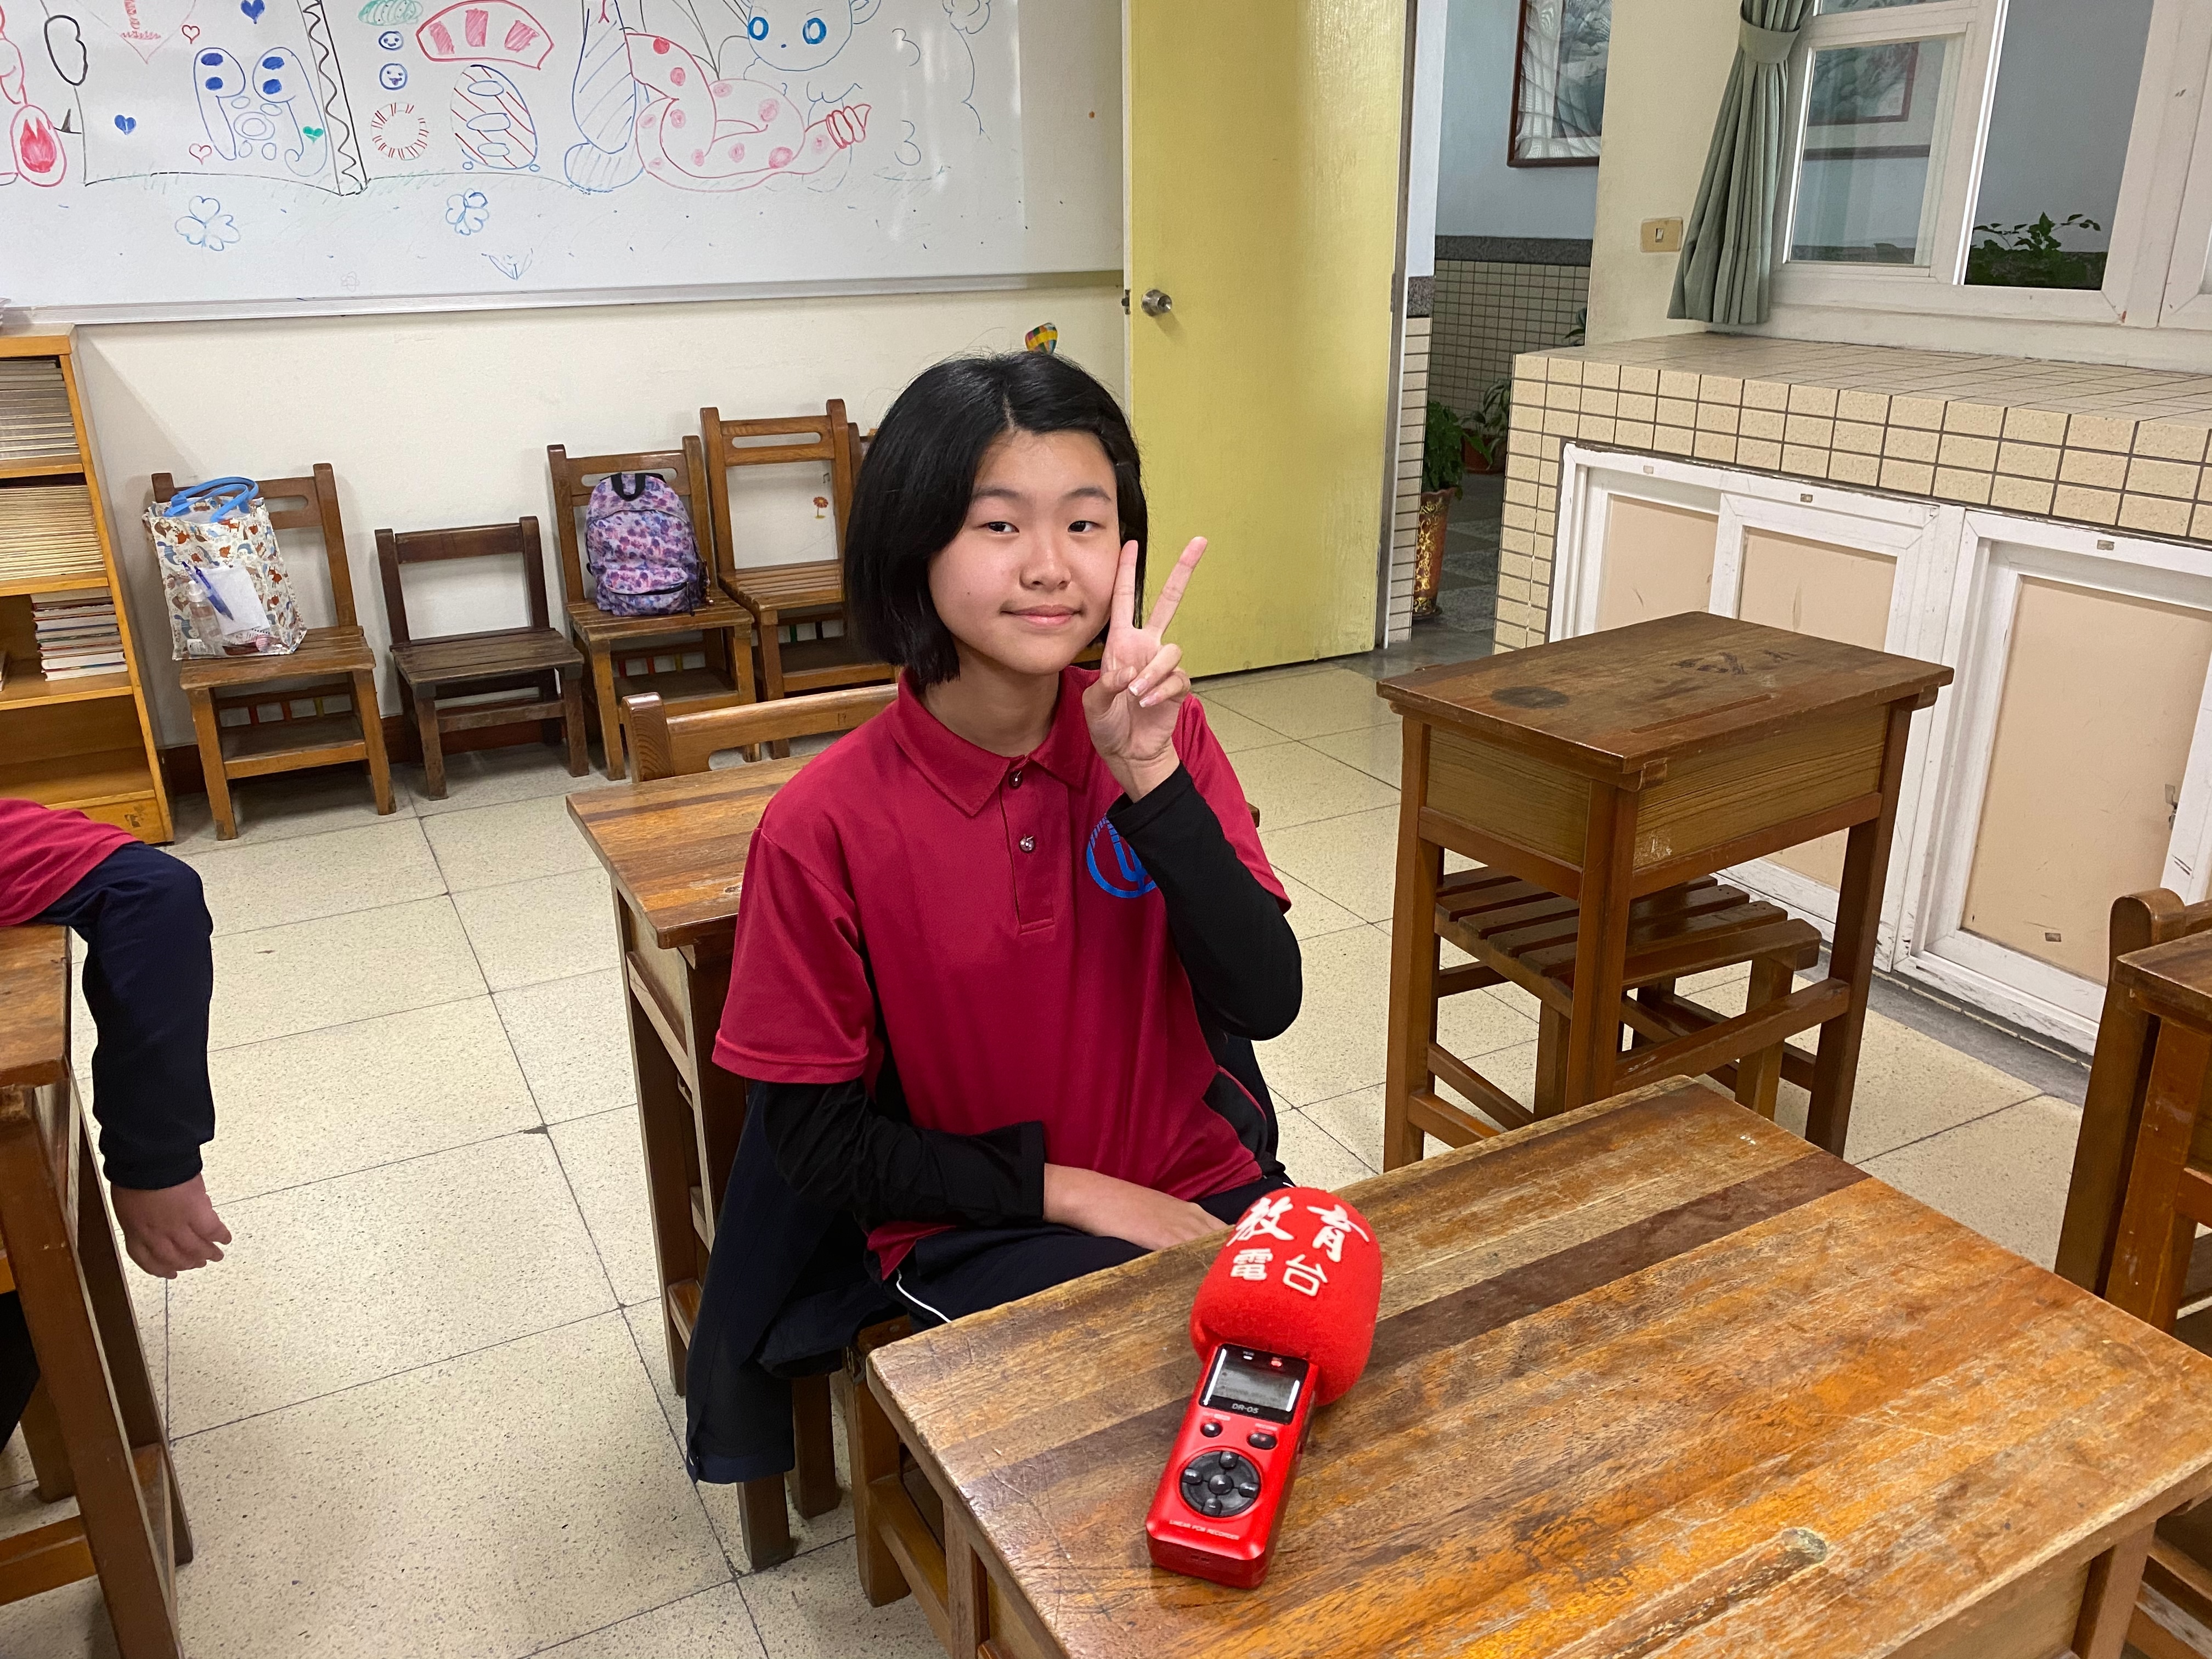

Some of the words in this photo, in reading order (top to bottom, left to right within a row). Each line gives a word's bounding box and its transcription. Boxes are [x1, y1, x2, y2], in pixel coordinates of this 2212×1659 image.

[1226, 1195, 1370, 1263] 教育
[1230, 1248, 1328, 1297] 電台
[1232, 1403, 1260, 1414] DR-05
